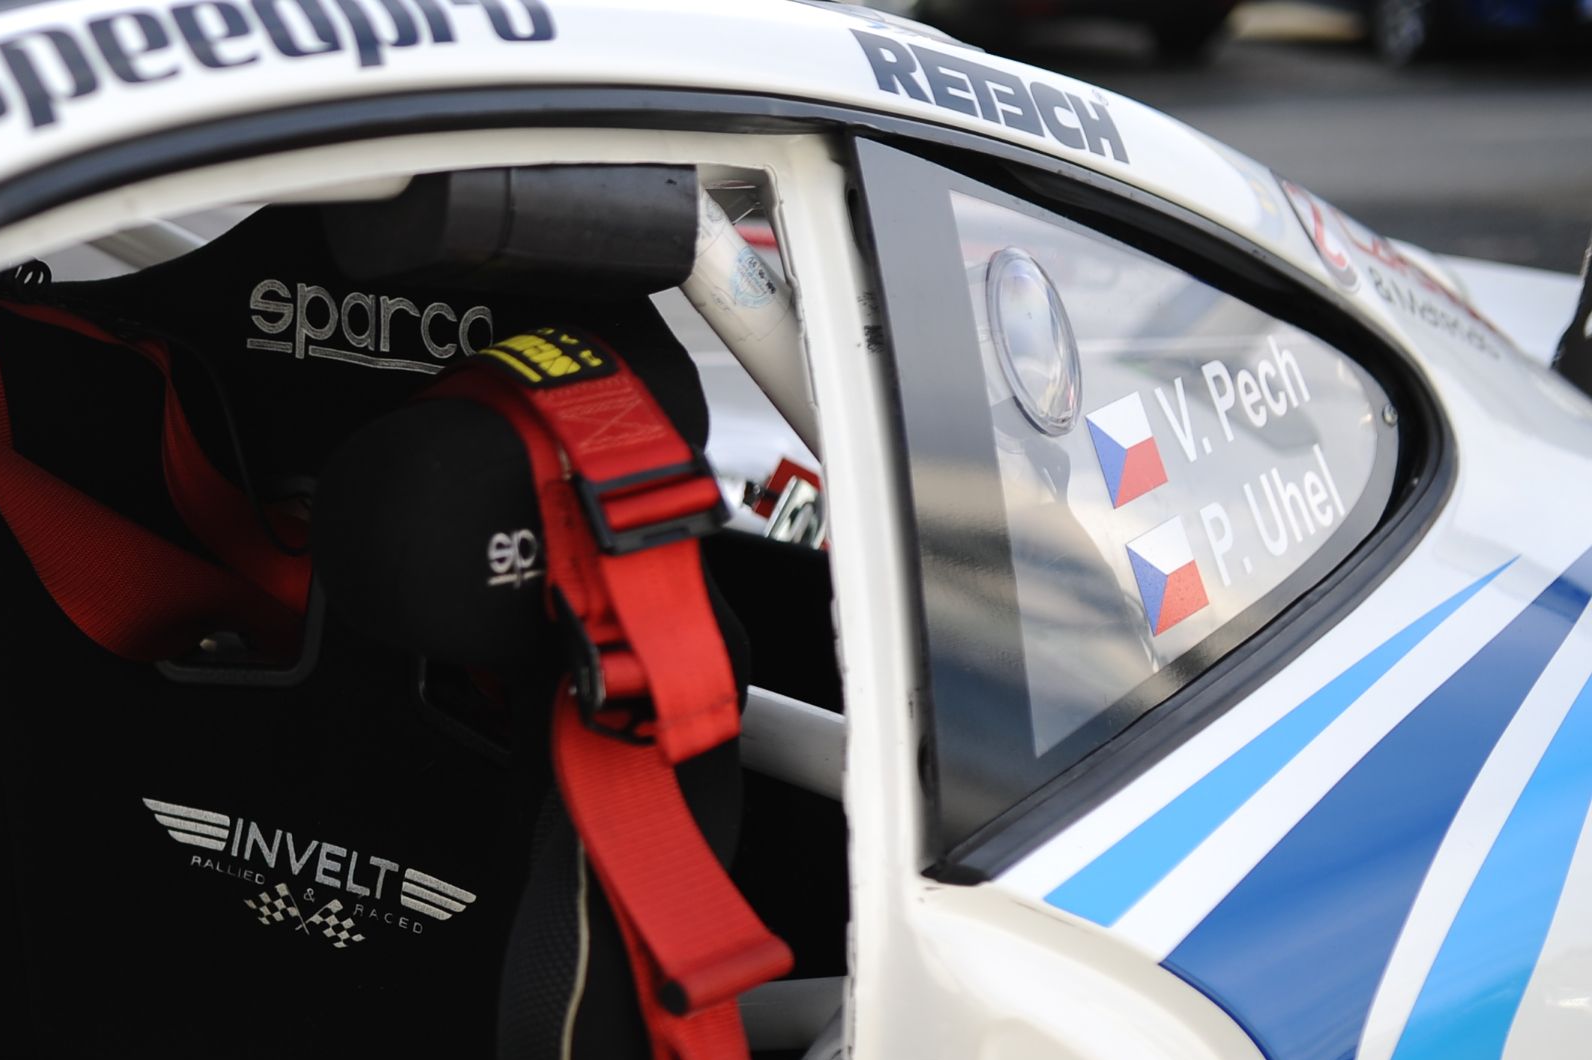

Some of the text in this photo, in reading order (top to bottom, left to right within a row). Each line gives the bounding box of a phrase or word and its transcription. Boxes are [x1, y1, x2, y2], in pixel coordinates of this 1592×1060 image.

[250, 279, 494, 359] sparco
[1154, 335, 1310, 462] V. Pech
[1199, 444, 1345, 587] P. Uhel
[190, 855, 424, 935] RALLIED & RACED
[230, 817, 400, 900] INVELT
